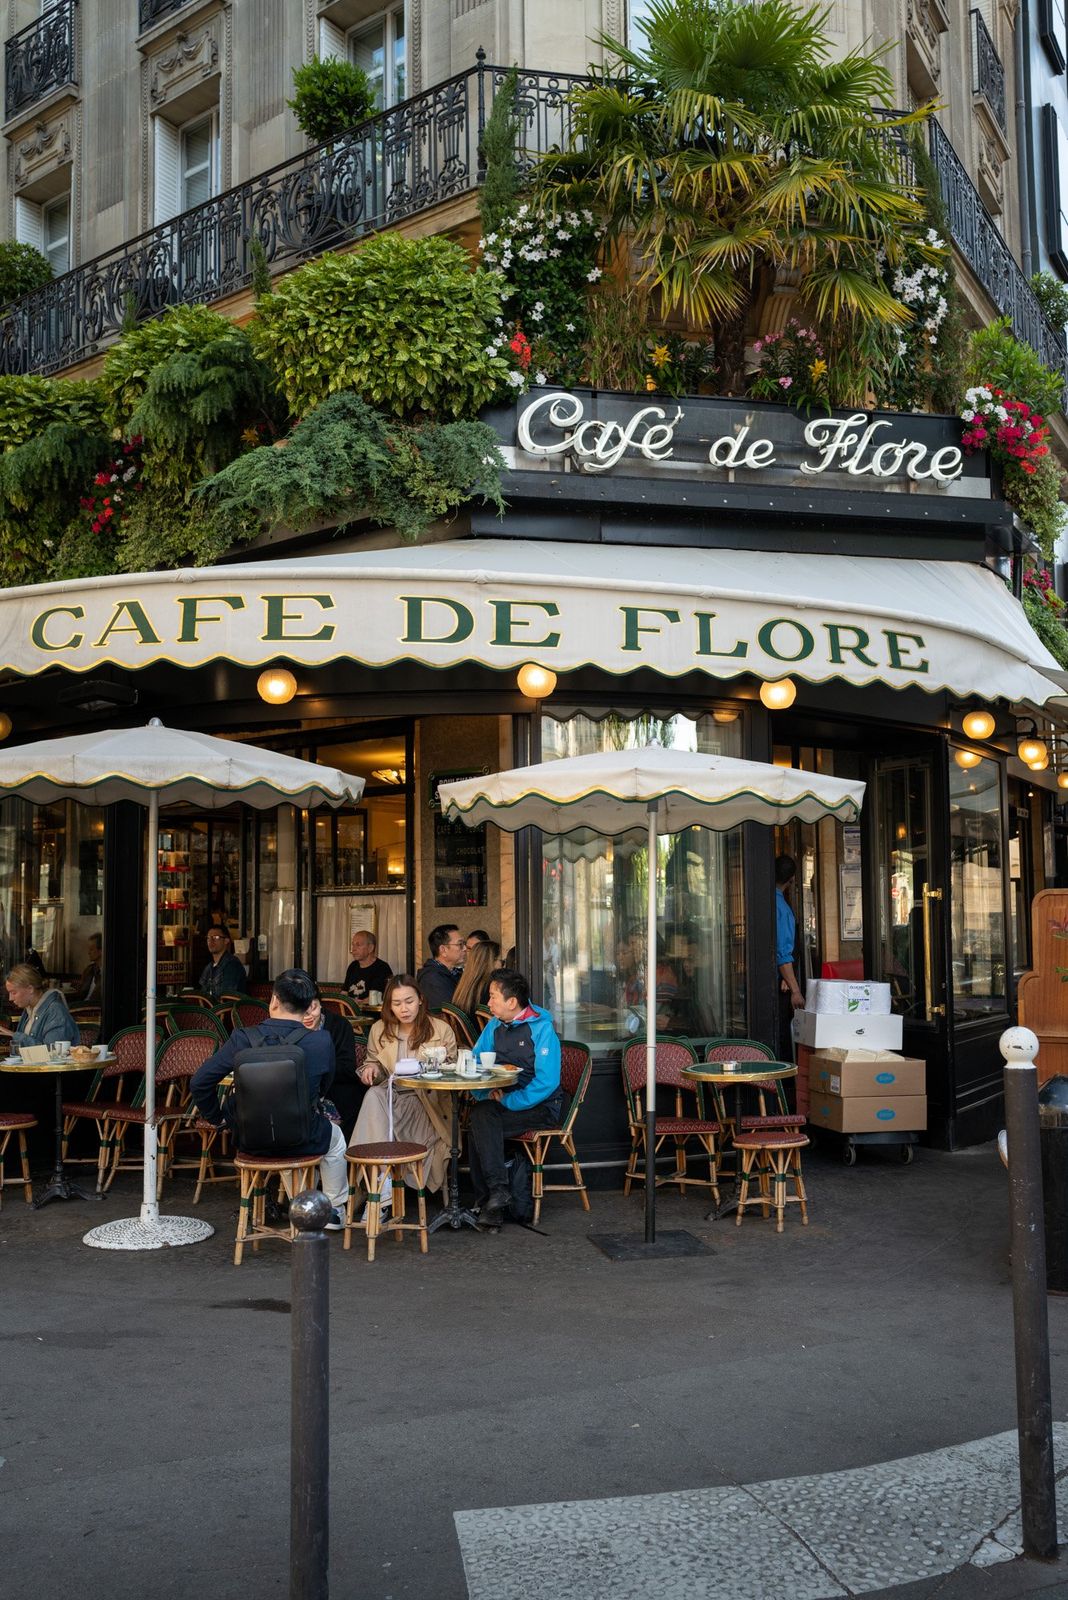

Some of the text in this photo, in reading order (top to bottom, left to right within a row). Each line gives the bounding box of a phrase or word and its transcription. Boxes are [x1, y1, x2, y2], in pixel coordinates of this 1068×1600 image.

[517, 392, 963, 481] Café de Flore
[30, 593, 930, 673] CAFE DE FLORE
